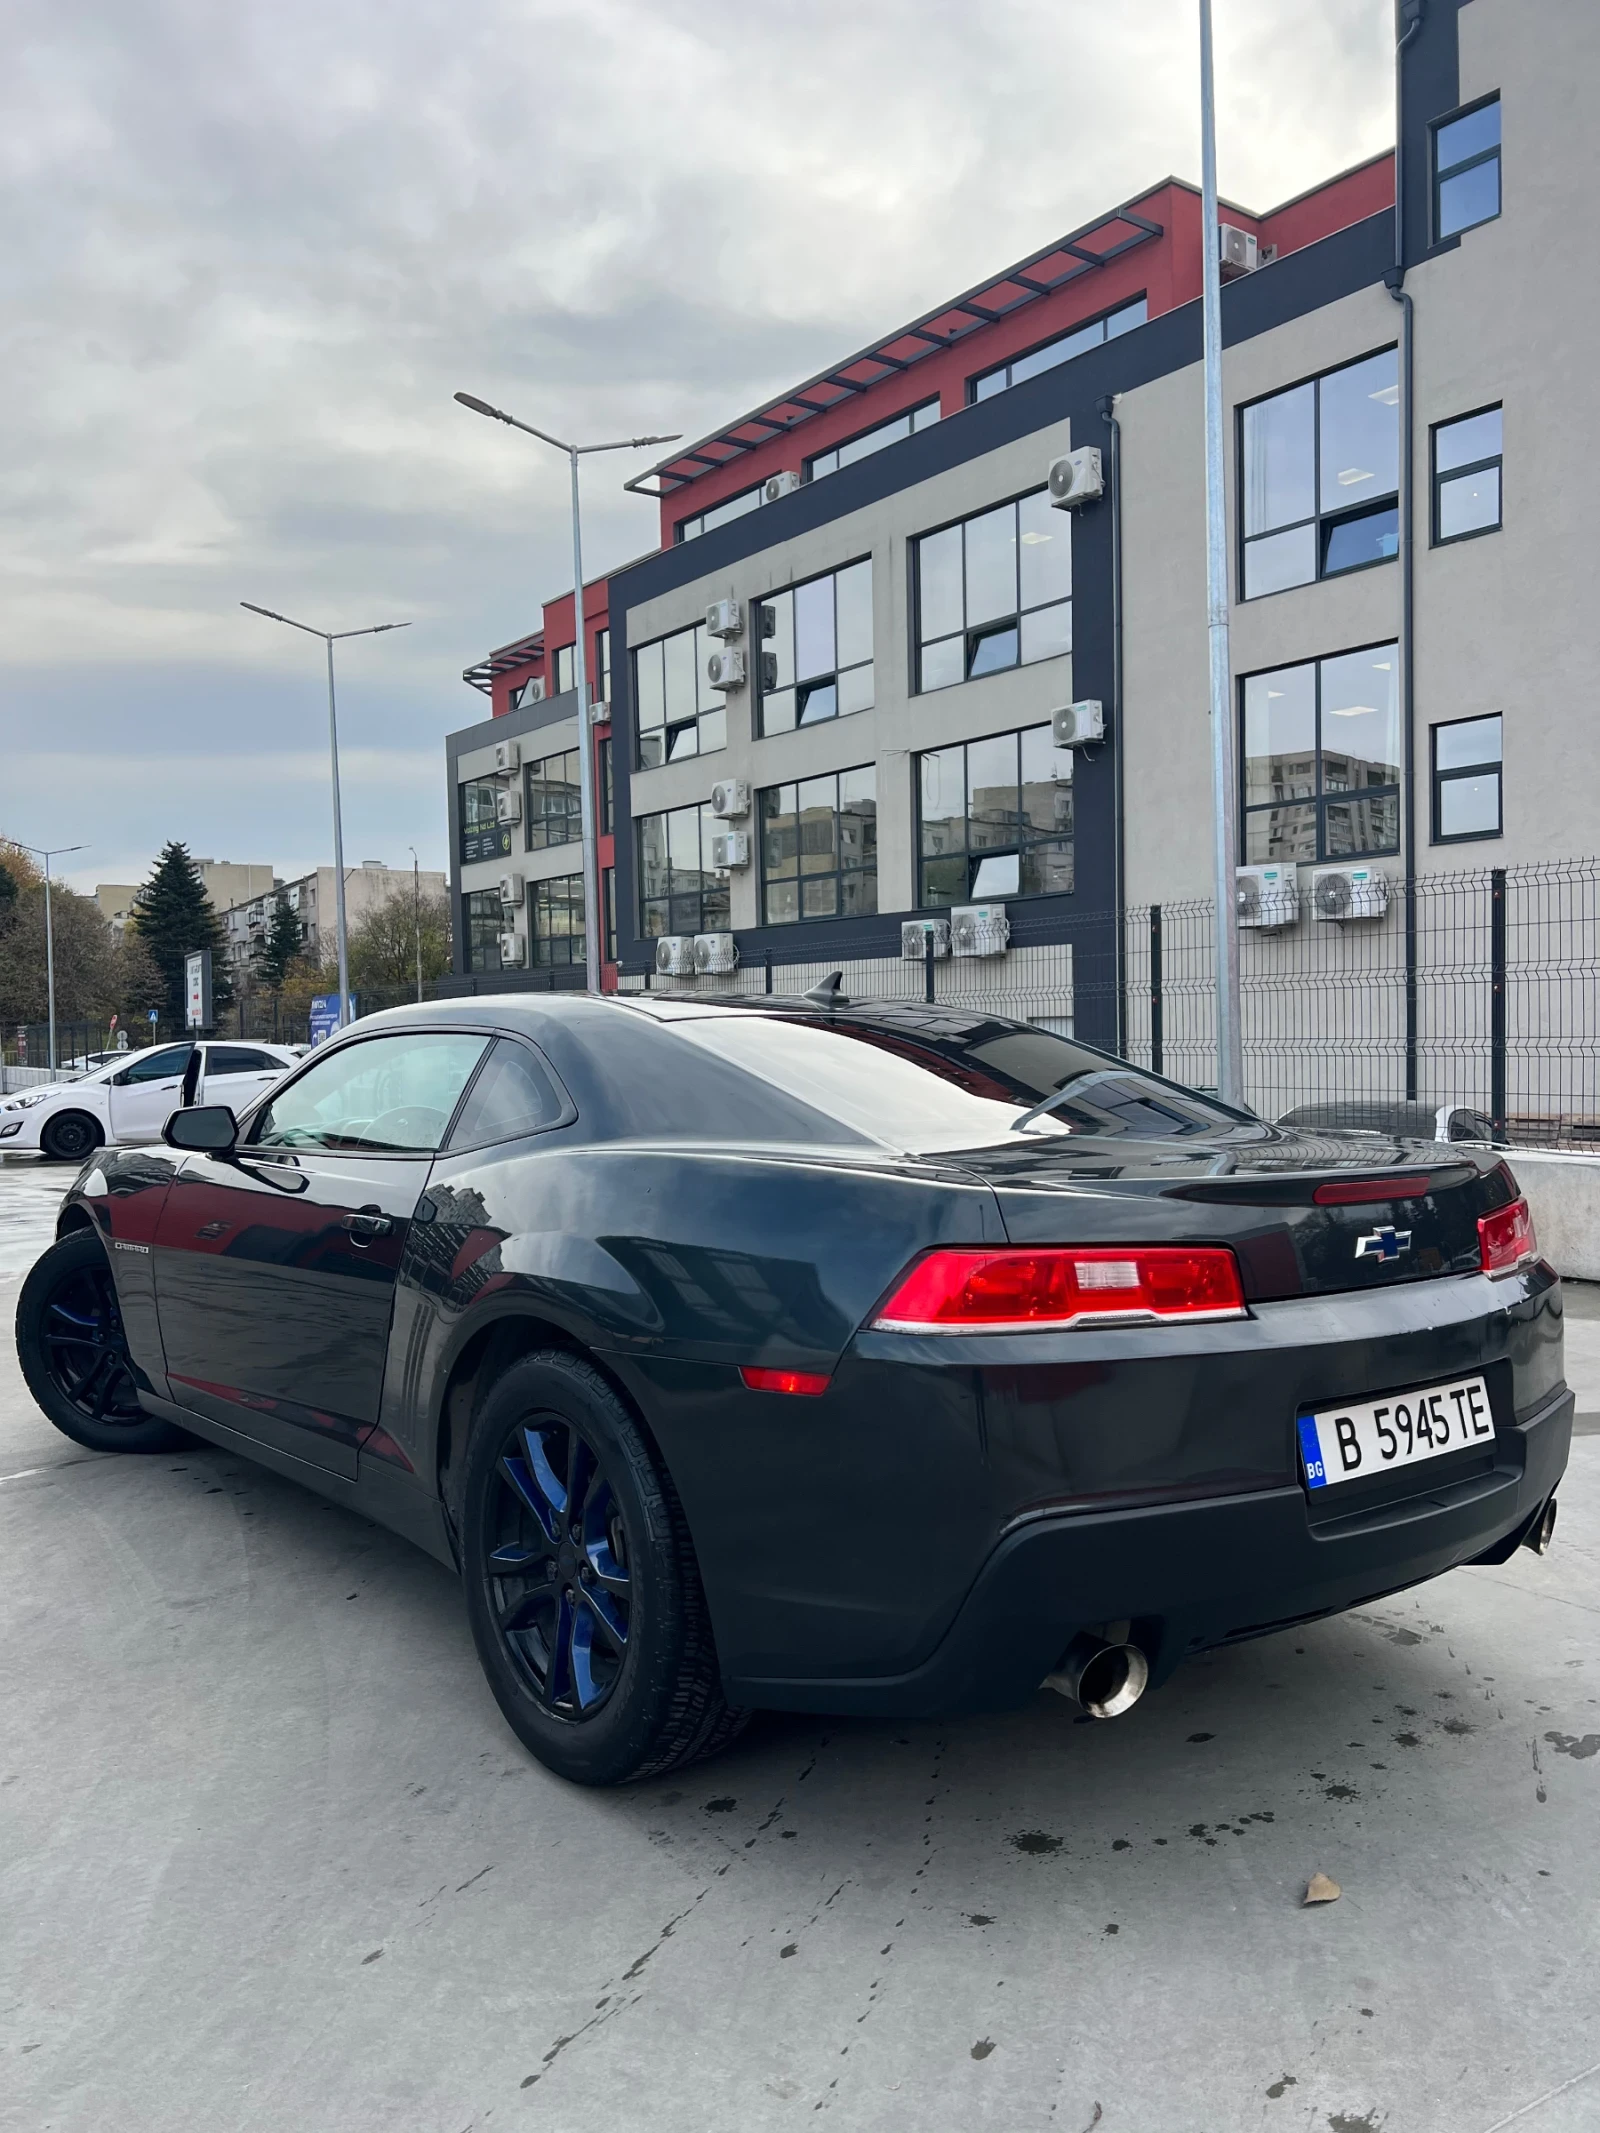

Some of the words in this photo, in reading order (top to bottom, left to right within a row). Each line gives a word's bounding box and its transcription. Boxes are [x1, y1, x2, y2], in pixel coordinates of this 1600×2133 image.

[1335, 1416, 1362, 1472] B
[1374, 1394, 1450, 1460] 5945
[1450, 1385, 1489, 1439] TE
[1306, 1462, 1324, 1479] BG
